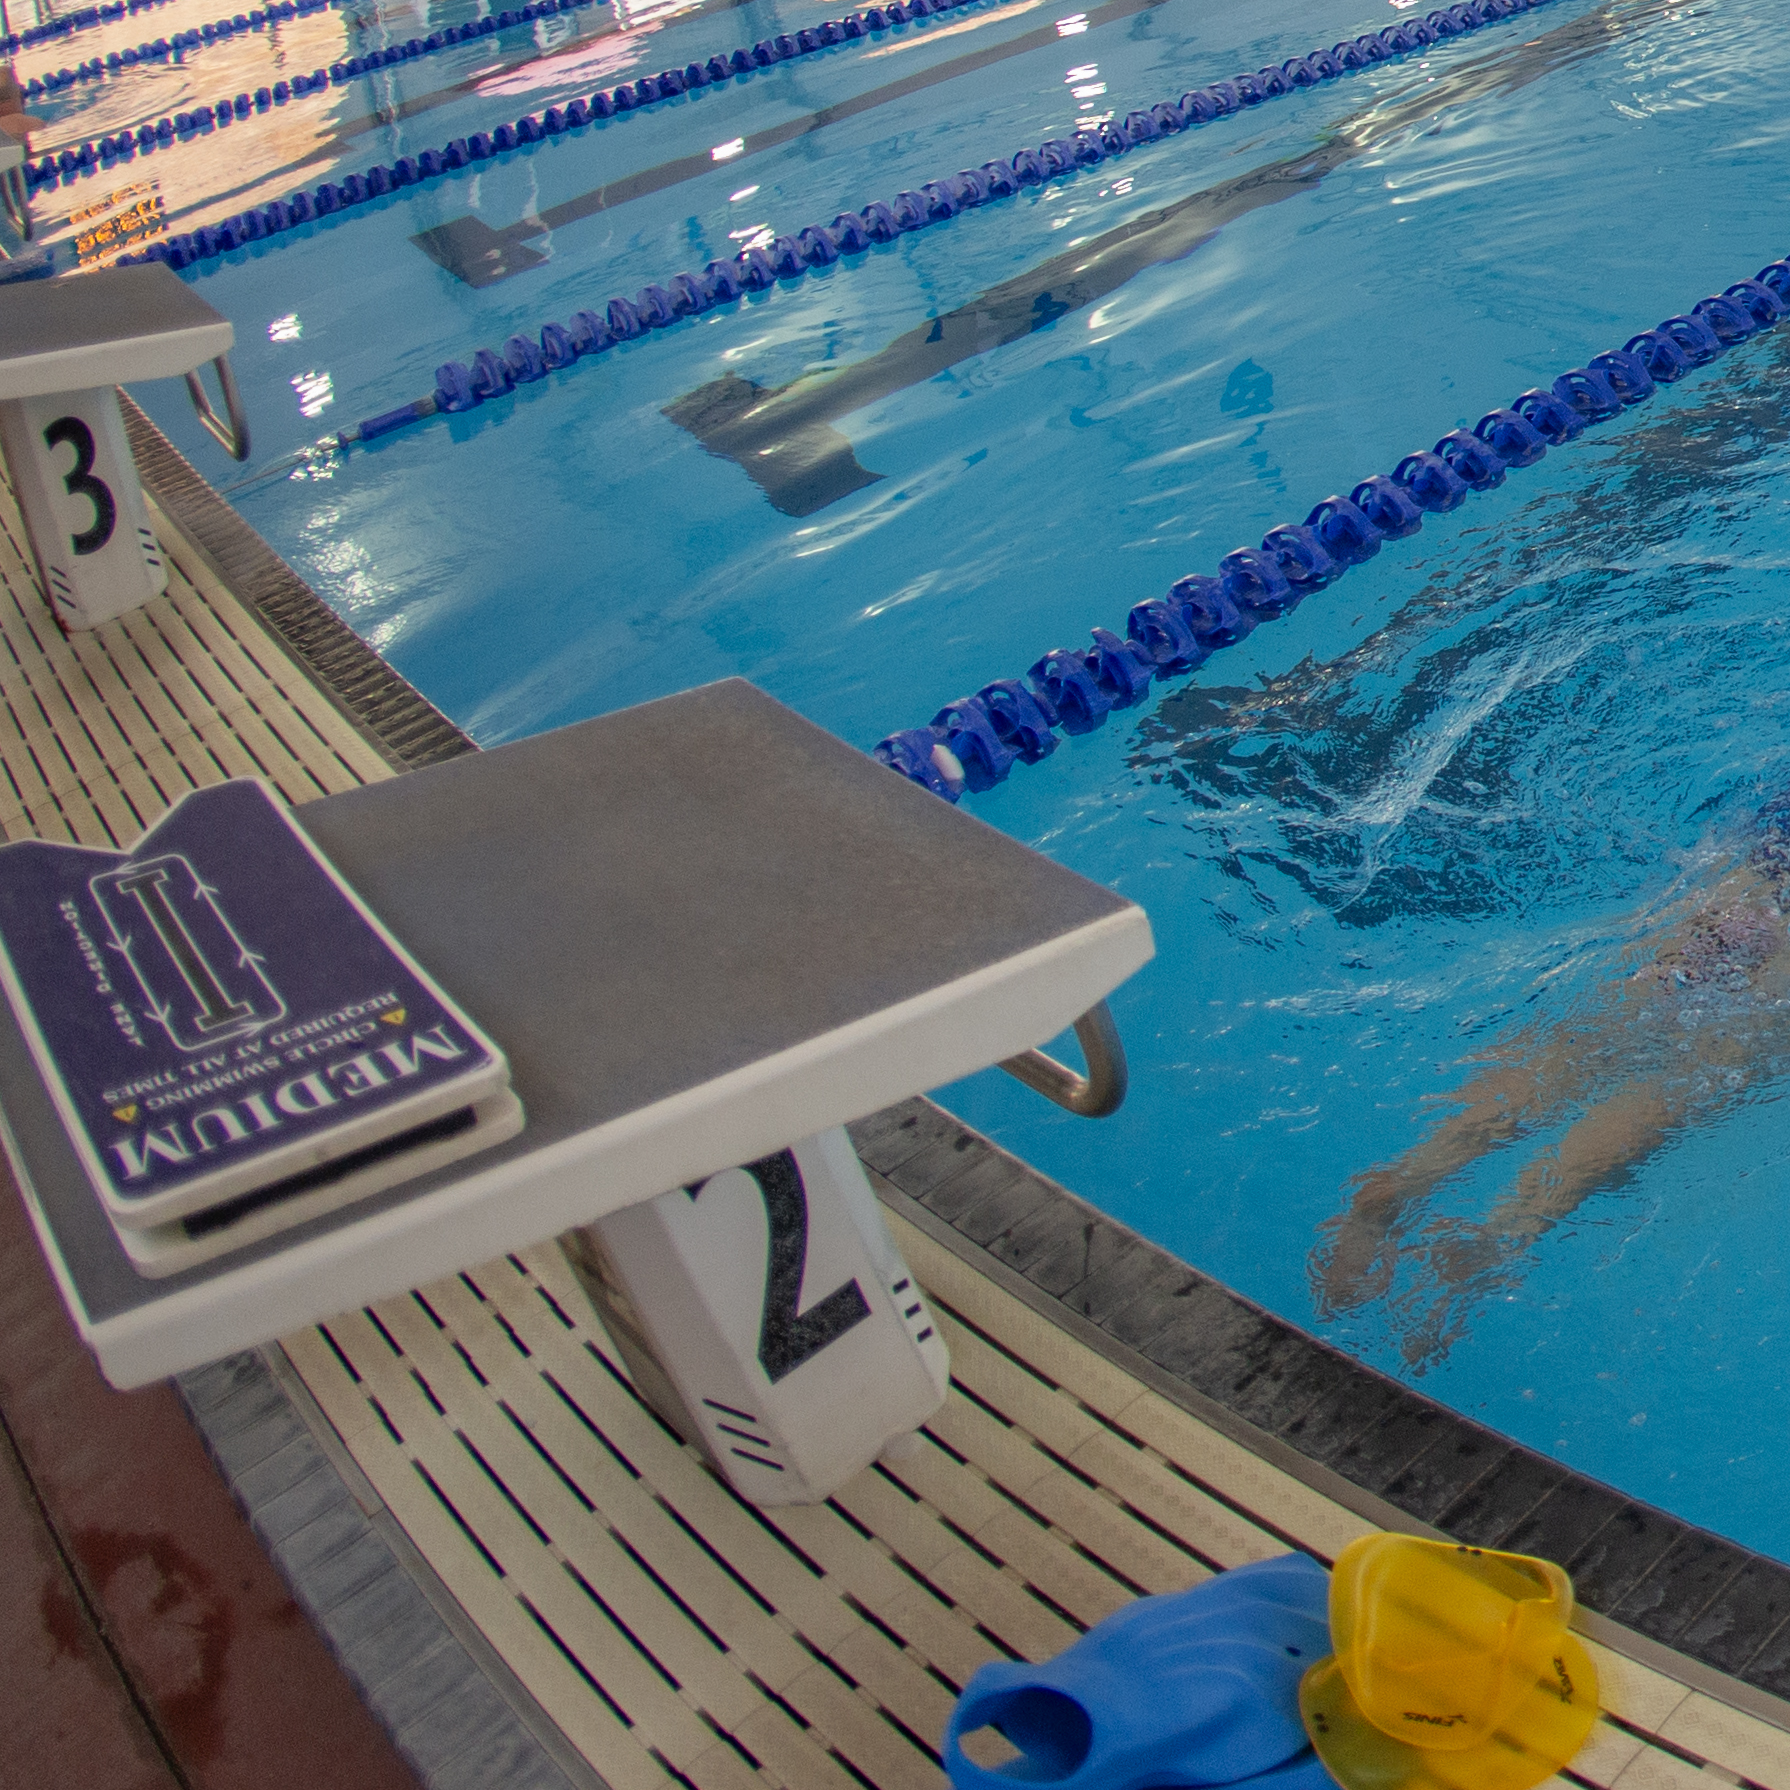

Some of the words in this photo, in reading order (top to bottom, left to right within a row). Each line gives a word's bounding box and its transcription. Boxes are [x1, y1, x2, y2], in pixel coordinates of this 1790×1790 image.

[43, 416, 117, 555] 3
[58, 901, 112, 993] DIRECTION
[110, 1001, 145, 1047] LANE
[269, 991, 399, 1047] REQUIRED
[284, 1020, 377, 1062] CIRCLE
[181, 1053, 228, 1074] ALL
[235, 1040, 263, 1061] AT
[102, 1069, 179, 1104] TIMES
[110, 1025, 467, 1180] MEDIUM
[145, 1056, 281, 1109] SWIMMING
[682, 1147, 873, 1385] 2
